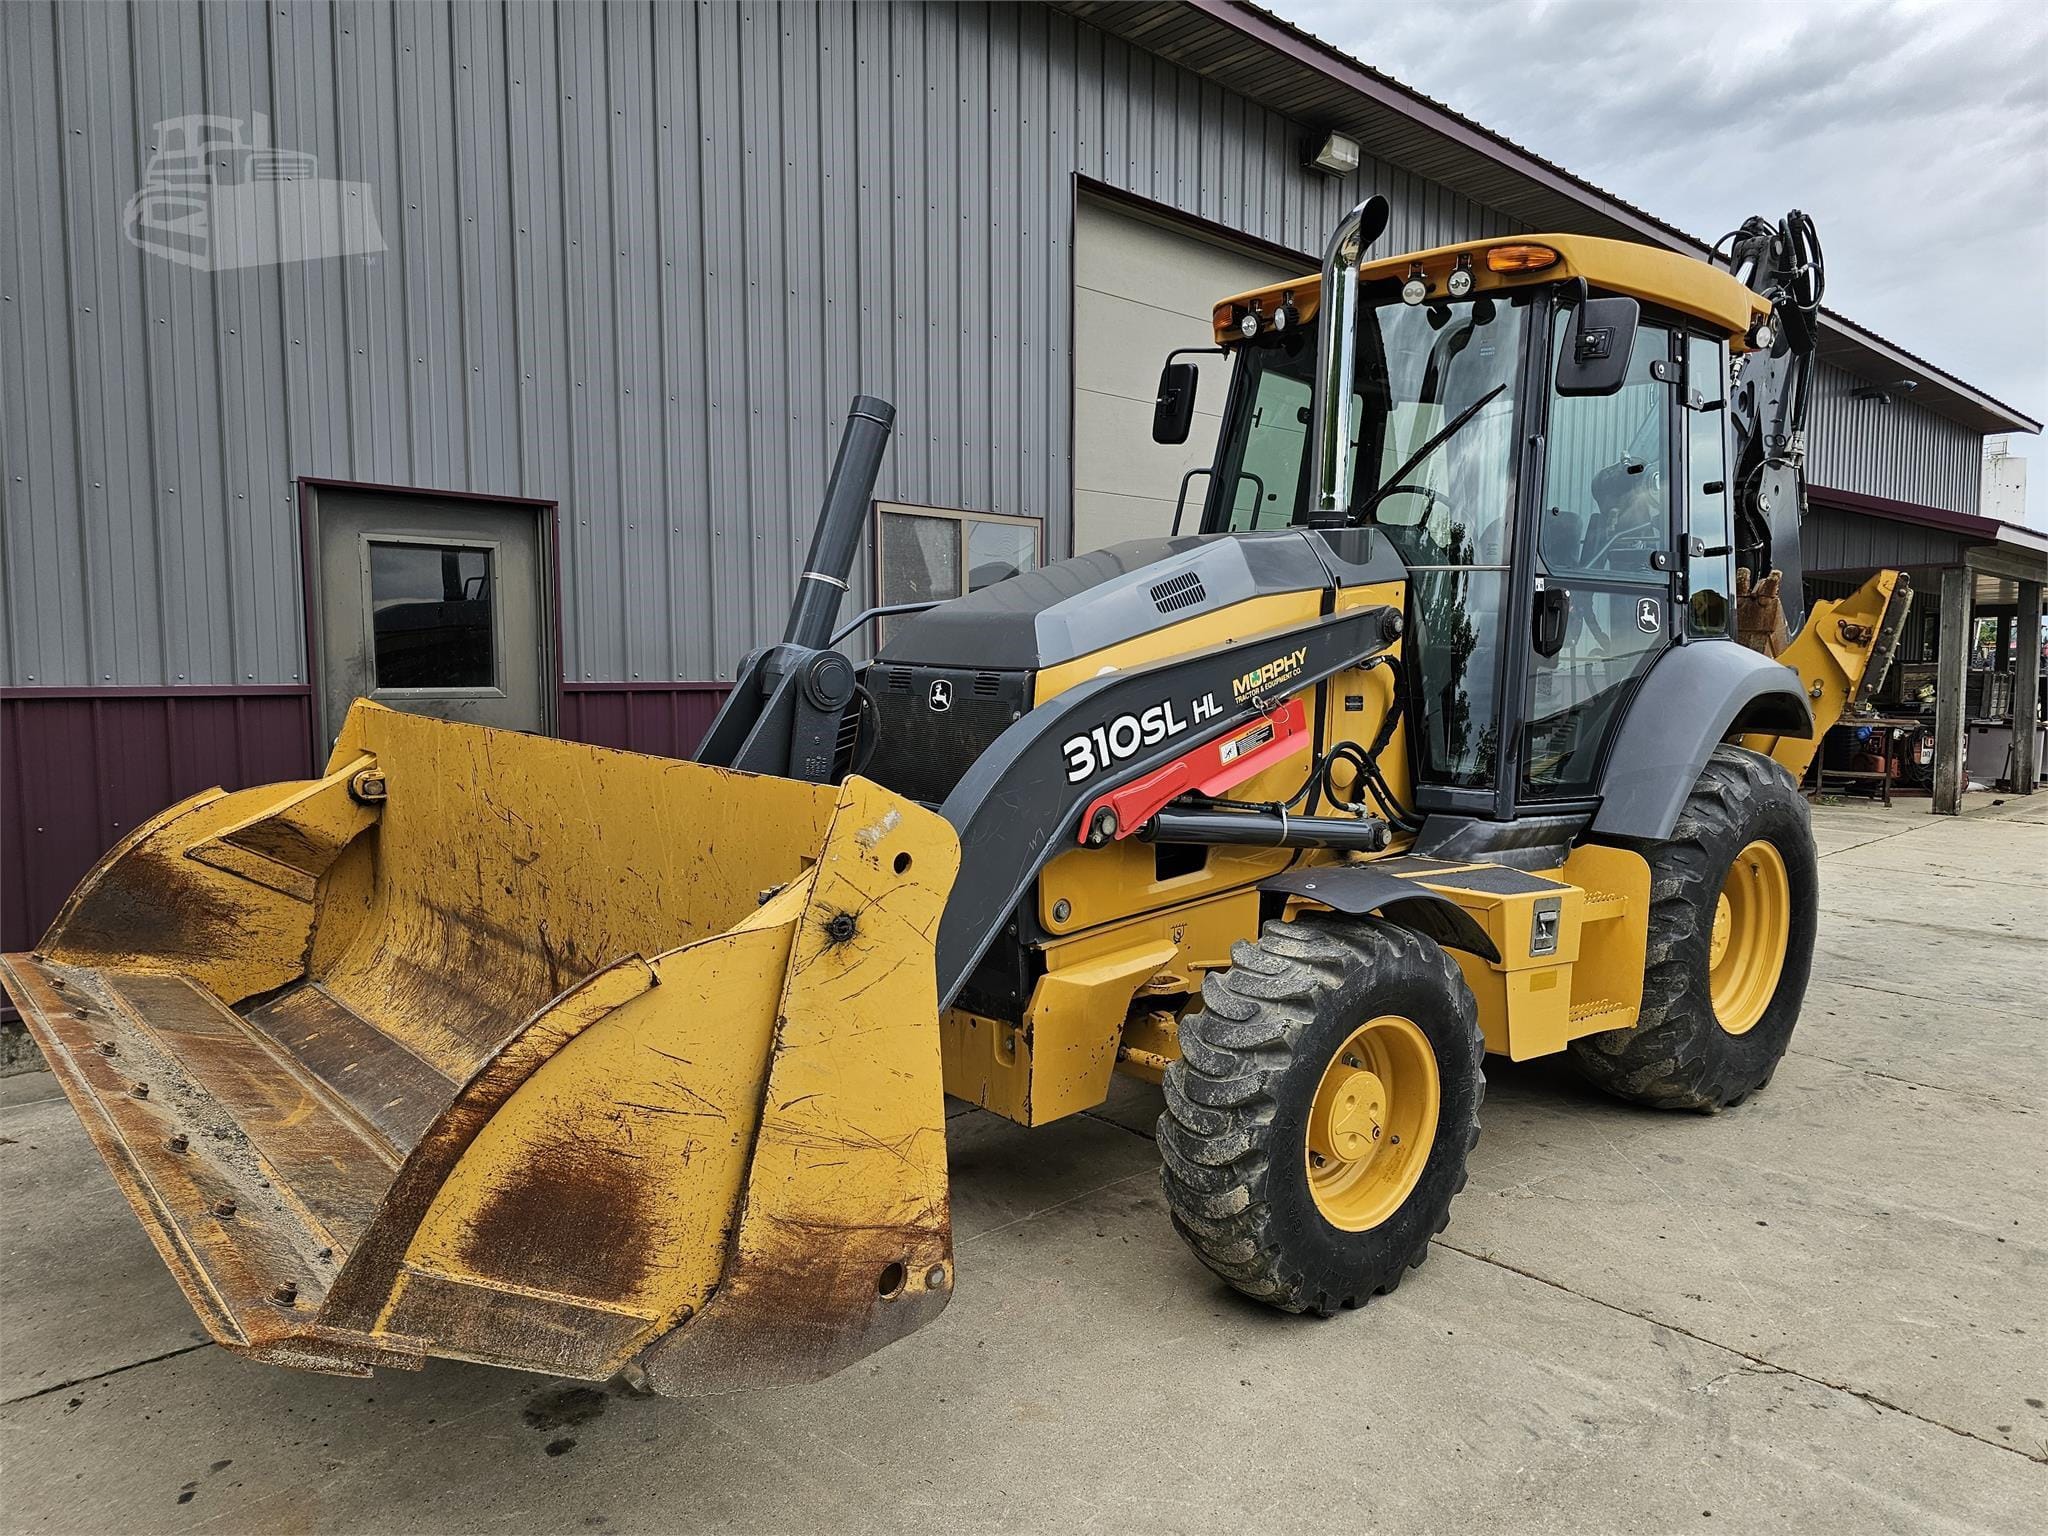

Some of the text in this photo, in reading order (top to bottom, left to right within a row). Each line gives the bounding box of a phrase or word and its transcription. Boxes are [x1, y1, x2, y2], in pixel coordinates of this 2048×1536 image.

[1232, 646, 1307, 697] MURPHY
[1235, 687, 1260, 704] TRACTOR
[1264, 671, 1293, 690] EQUIPMENT
[1062, 700, 1188, 783] 310SL
[1192, 692, 1224, 724] HL
